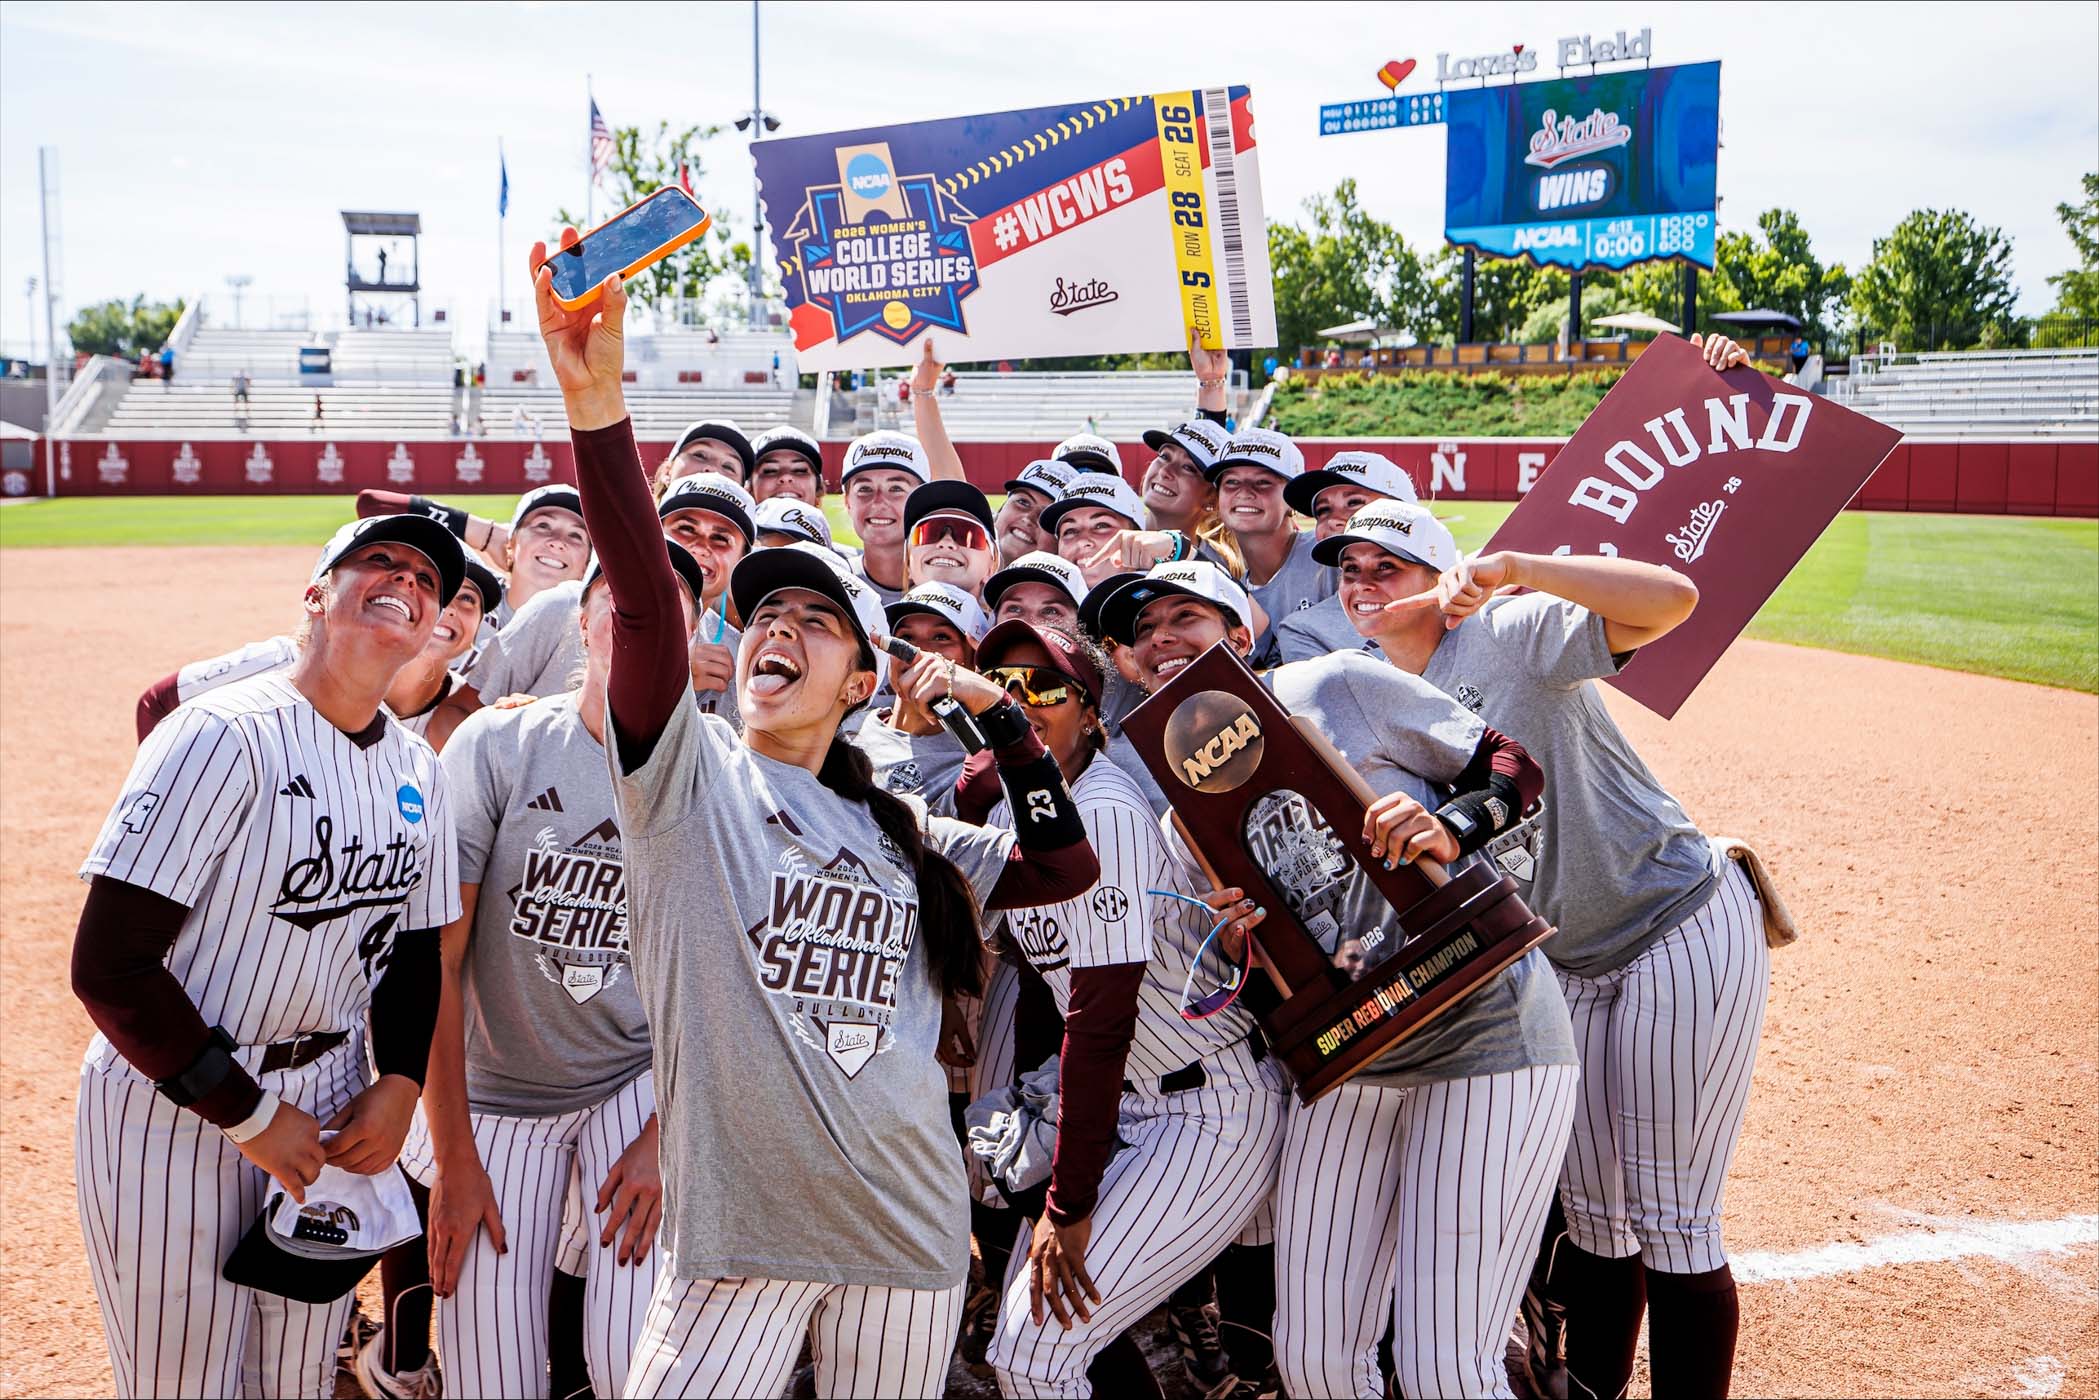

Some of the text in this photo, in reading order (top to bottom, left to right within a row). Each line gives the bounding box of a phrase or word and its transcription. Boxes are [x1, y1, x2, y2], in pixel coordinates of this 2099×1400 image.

[1557, 28, 1651, 67] Field
[1525, 108, 1632, 168] State
[851, 173, 891, 190] NCAA
[1538, 168, 1608, 210] WINS
[993, 158, 1133, 251] #WCWS
[834, 220, 926, 239] 2026 WOMEN'S
[1161, 105, 1212, 340] SECTION 5 ROW 28 SEAT 26
[1513, 225, 1578, 249] NCAA
[836, 232, 931, 265] COLLEGE
[1594, 235, 1645, 258] 0:00
[808, 256, 971, 294] WORLD SERIES
[846, 286, 941, 304] OKLAHOMA CITY
[1049, 276, 1119, 316] State
[853, 443, 914, 466] Champions
[1220, 440, 1281, 460] Champions
[1567, 392, 1814, 525] BOUND
[1057, 485, 1116, 501] Champions
[1664, 475, 1743, 565] State 26
[1181, 712, 1262, 787] NCAA
[1026, 789, 1058, 823] 23
[565, 847, 601, 857] WOMEN'S
[268, 815, 423, 932] State
[816, 868, 860, 882] WOMEN'S
[534, 884, 616, 912] Oklahoma
[1093, 887, 1129, 922] SEC
[784, 918, 882, 955] Oklahoma
[567, 969, 599, 987] State
[1316, 931, 1478, 1056] SUPER REGIONAL CHAMPION
[834, 1030, 870, 1054] State
